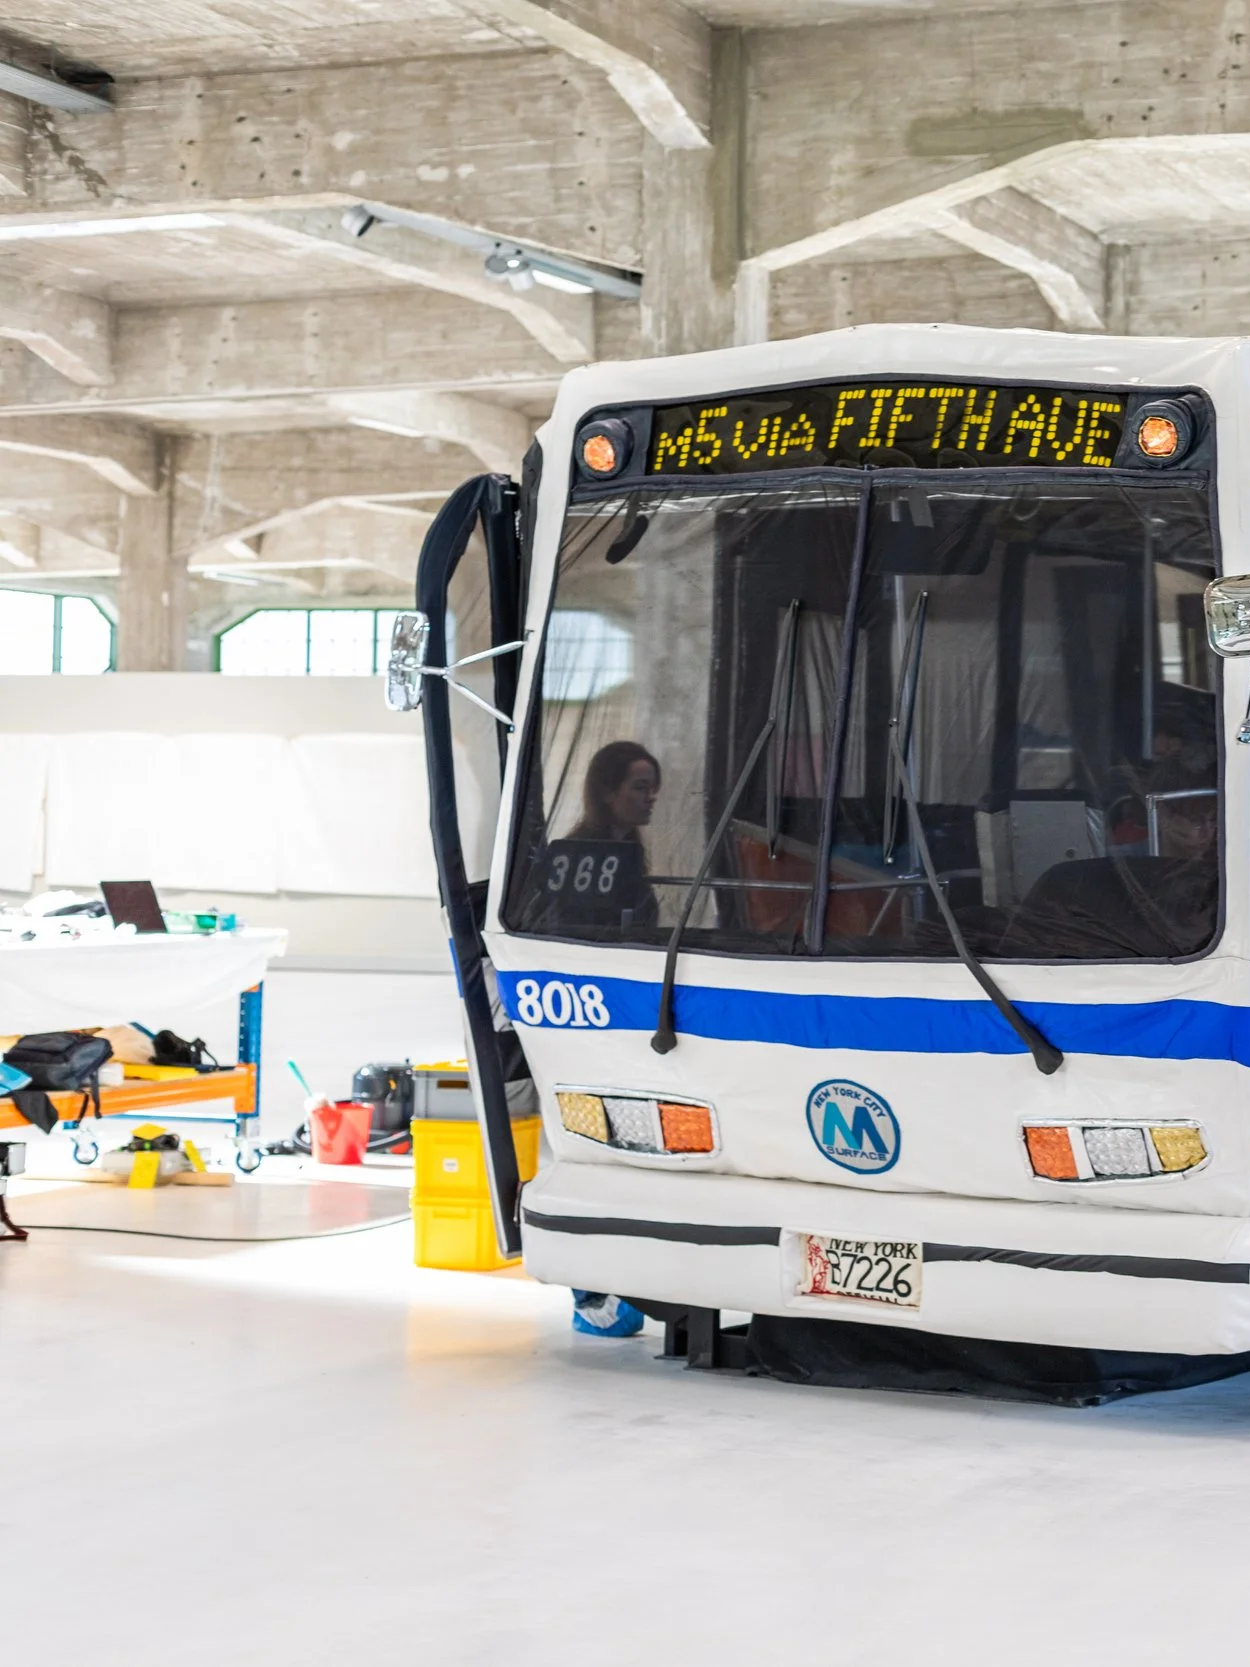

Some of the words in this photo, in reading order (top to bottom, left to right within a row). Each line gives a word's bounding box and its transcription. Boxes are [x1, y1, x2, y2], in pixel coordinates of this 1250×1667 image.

[653, 406, 728, 471] M5
[732, 413, 816, 460] VIA
[827, 387, 997, 451] FIFTH
[1003, 394, 1121, 468] AVE
[547, 855, 619, 893] 368
[516, 979, 611, 1028] 8018
[814, 1088, 831, 1109] NEW
[832, 1086, 862, 1100] YORK
[863, 1097, 887, 1118] CITY
[826, 1146, 888, 1161] SURFACE
[829, 1238, 867, 1254] NEW
[872, 1241, 918, 1259] YORK
